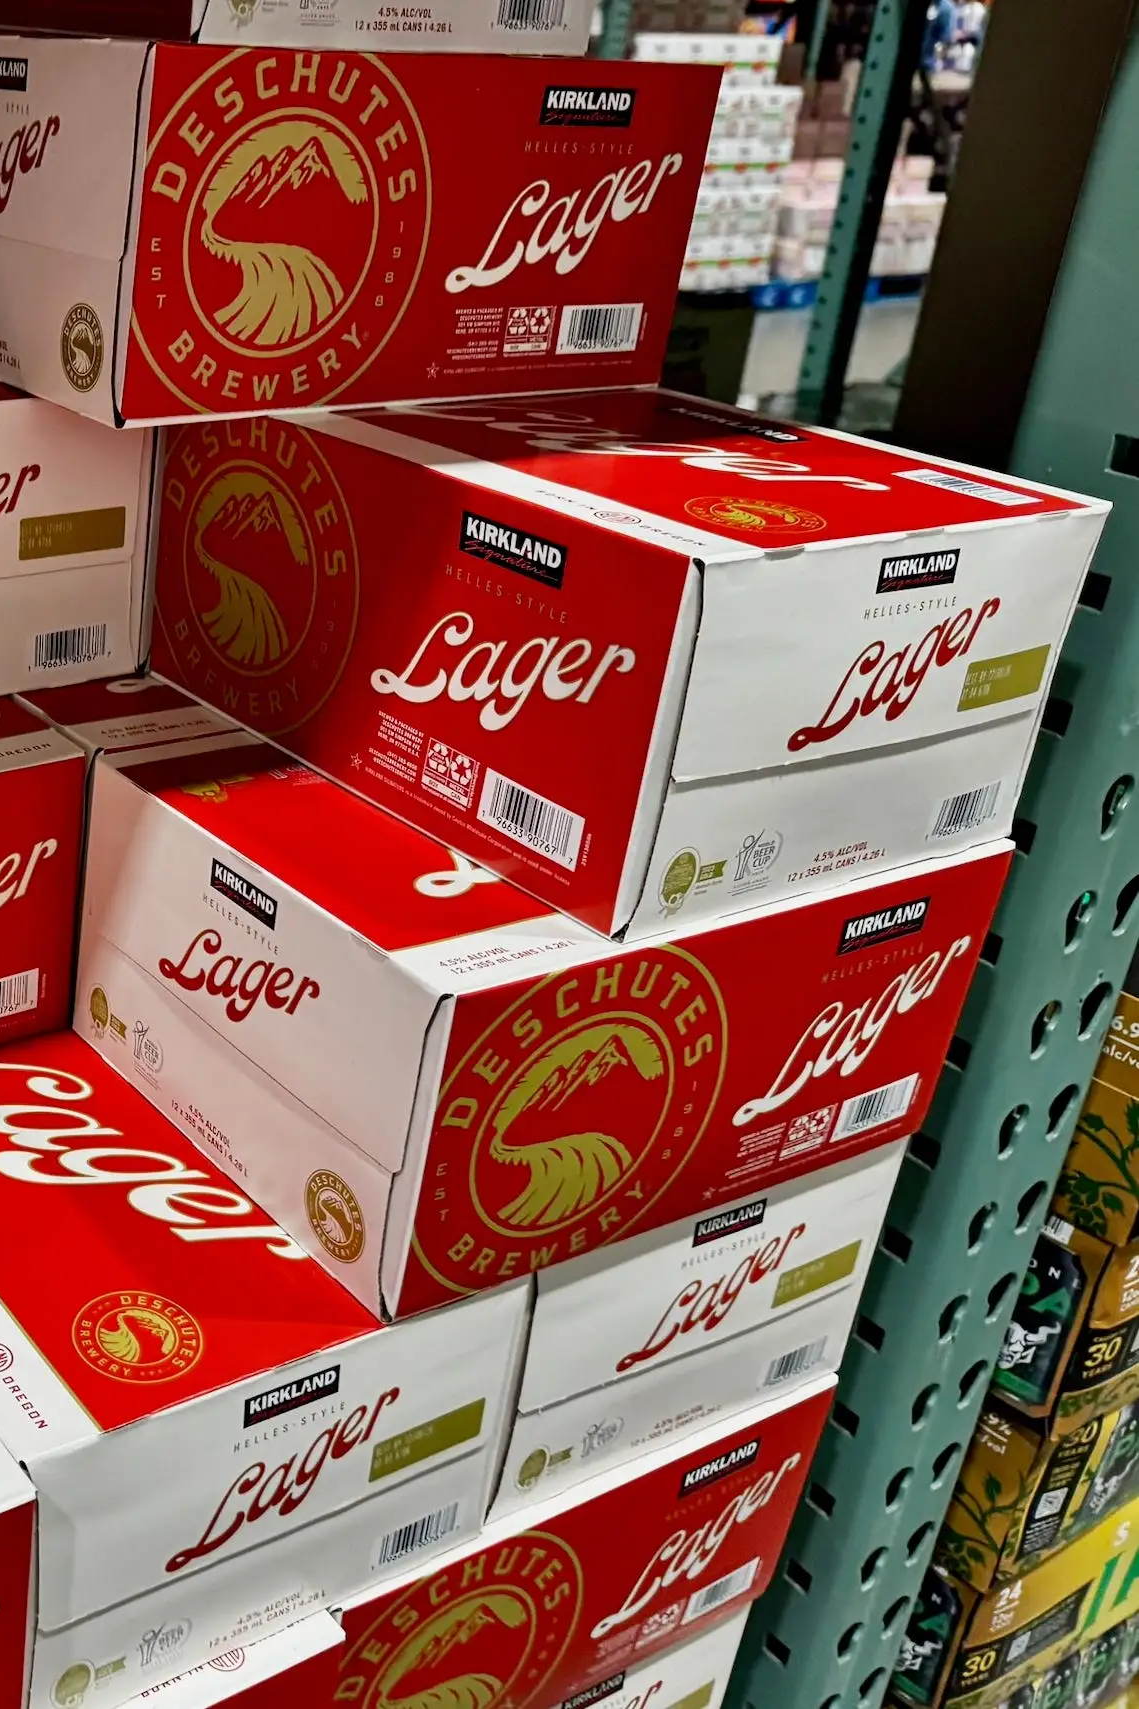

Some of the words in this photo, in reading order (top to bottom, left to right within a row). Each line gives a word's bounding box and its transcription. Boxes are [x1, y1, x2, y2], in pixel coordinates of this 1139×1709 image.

[373, 21, 388, 31] 355
[390, 22, 400, 31] mL
[402, 22, 422, 32] CANS
[378, 7, 398, 17] 4.5%
[401, 8, 432, 18] ALC/VOL
[547, 90, 631, 111] KIRKLAND
[151, 53, 417, 203] DESCHUTES
[444, 152, 683, 294] Lager
[168, 322, 362, 402] BREWERY
[465, 515, 562, 569] KIRKLAND
[884, 554, 956, 579] KIRKLAND
[444, 563, 568, 624] HELLES-STYLE
[864, 596, 958, 620] HELLES-STYLE
[174, 618, 299, 716] BREWERY
[370, 611, 636, 732] Lager
[787, 597, 1001, 752] Lager
[496, 816, 523, 838] 96633
[527, 832, 557, 856] 90767
[813, 851, 834, 863] 4.5%
[215, 864, 274, 915] KIRKLAND
[806, 866, 821, 877] 355
[835, 858, 856, 870] CANS
[843, 900, 928, 943] KIRKLAND
[158, 929, 321, 1023] Lager
[468, 946, 510, 962] ALC/VOL
[510, 949, 538, 960] CANS
[440, 960, 714, 1130] DESCHUTES
[732, 935, 972, 1127] Lager
[206, 1120, 231, 1148] ALC/VOL
[207, 1133, 224, 1153] CANS
[447, 1180, 644, 1276] BREWERY
[696, 1200, 766, 1240] KIRKLAND
[615, 1222, 806, 1373] Lager
[81, 1319, 132, 1377] BREWERY
[119, 1294, 196, 1369] DESCHUTES
[1084, 1336, 1123, 1369] 30
[3, 1375, 48, 1430] OREGON
[249, 1370, 337, 1414] KIRKLAND
[232, 1401, 347, 1454] HELLES-STYLE
[164, 1386, 401, 1573] Lager
[684, 1442, 757, 1487] KIRKLAND
[591, 1452, 802, 1639] Lager
[334, 1547, 570, 1700] DESCHUTES
[963, 1650, 997, 1678] 30
